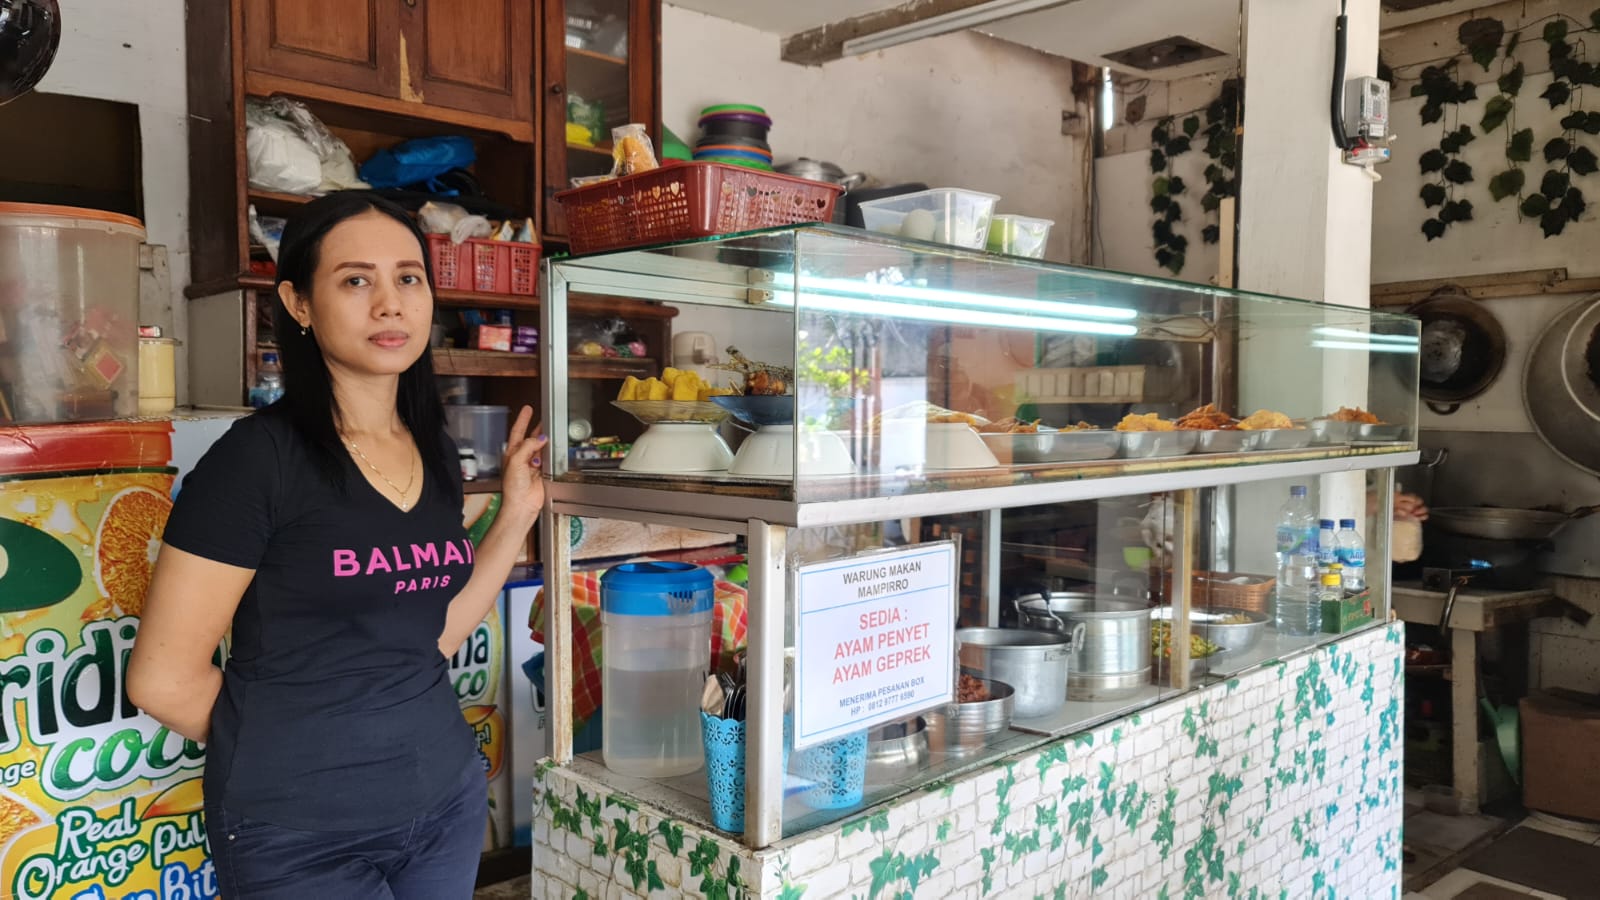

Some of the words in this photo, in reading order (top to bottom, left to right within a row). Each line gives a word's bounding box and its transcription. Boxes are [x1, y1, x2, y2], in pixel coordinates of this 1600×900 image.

[333, 538, 474, 577] BALMAI
[843, 567, 887, 584] WARUNG
[889, 561, 922, 576] MAKAN
[394, 575, 451, 594] PARIS
[857, 578, 909, 598] MAMPIRRO
[859, 607, 901, 630] SEDIA
[834, 635, 874, 660] AYAM
[878, 622, 930, 649] PENYET
[832, 660, 872, 685] AYAM
[876, 644, 931, 673] GEPREK
[839, 690, 877, 708] MENERIMA
[877, 681, 909, 697] PESANAN
[910, 676, 924, 687] BOX
[850, 706, 861, 717] HP
[58, 799, 137, 859] Real
[16, 842, 146, 900] Orange
